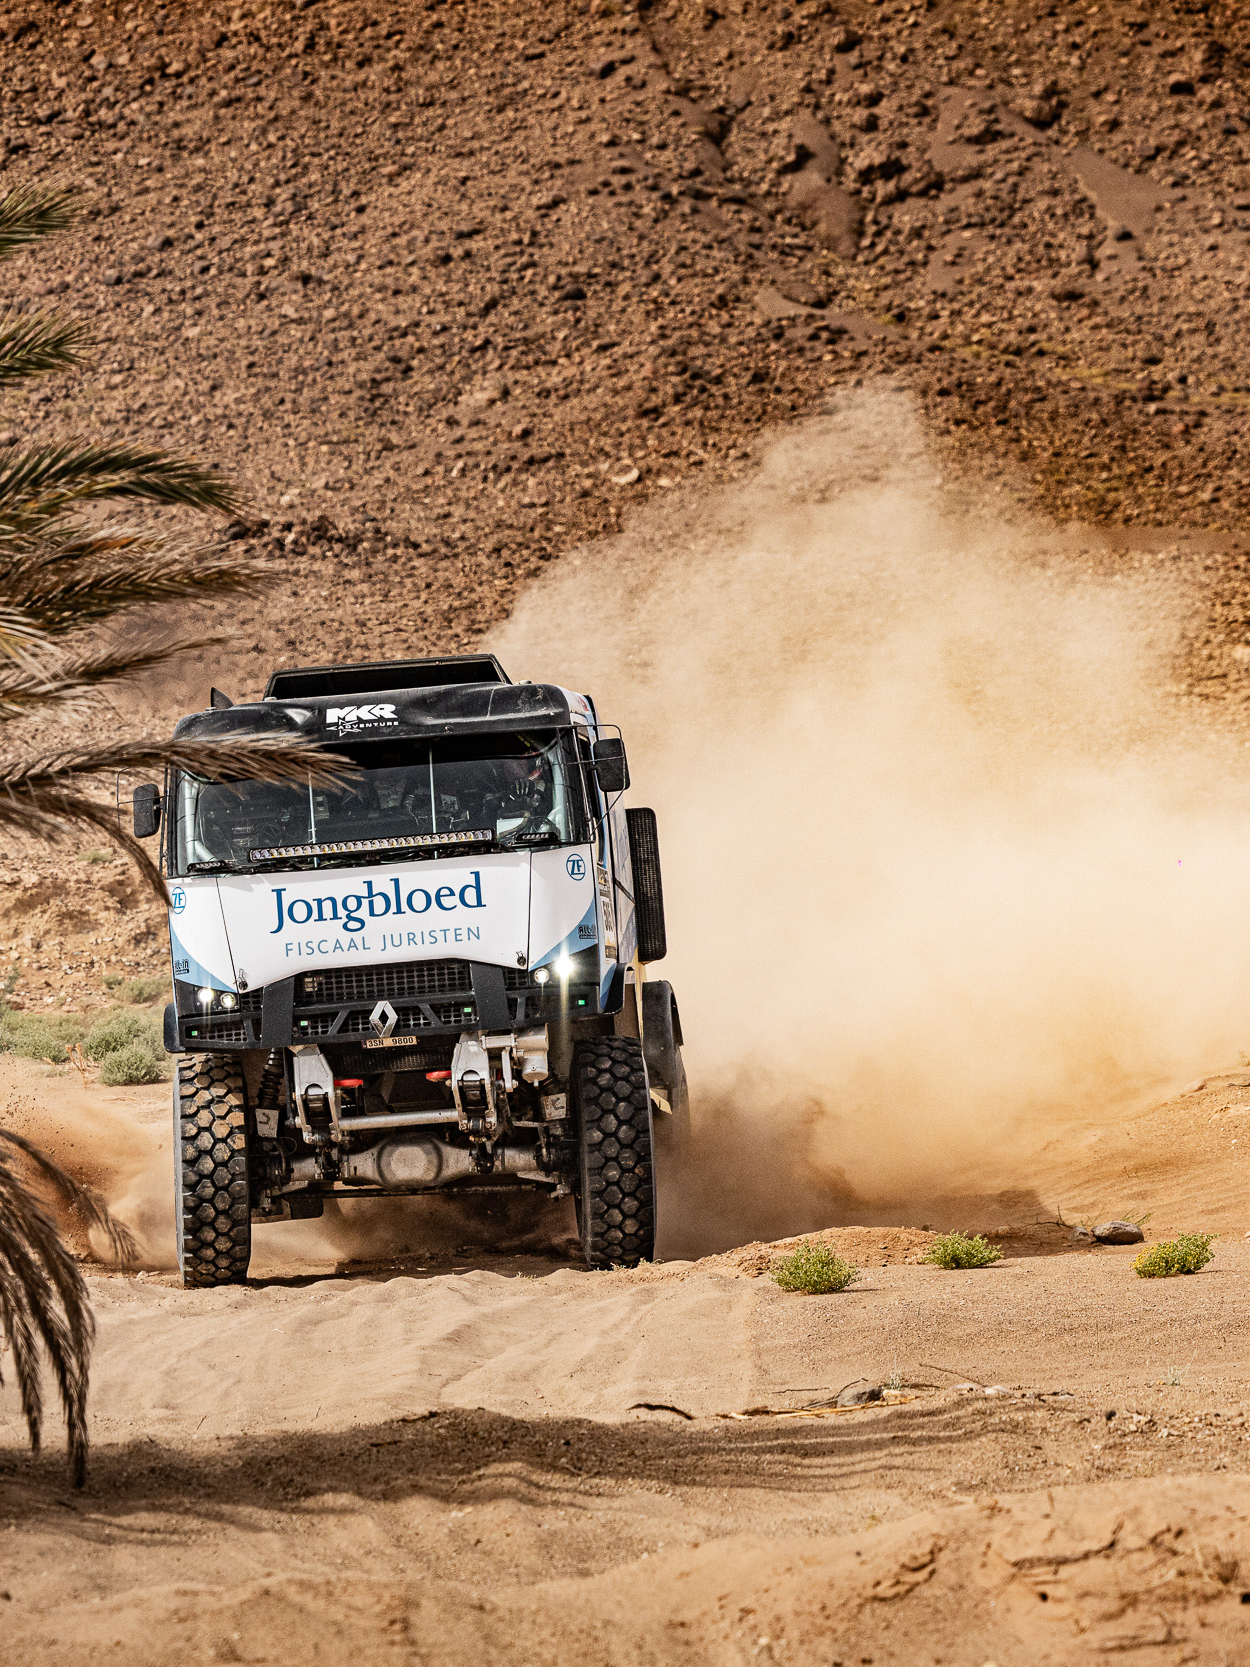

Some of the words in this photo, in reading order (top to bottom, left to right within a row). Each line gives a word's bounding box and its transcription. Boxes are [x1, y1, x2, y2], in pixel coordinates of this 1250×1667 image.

[326, 704, 398, 723] MKR
[338, 721, 399, 730] ADVENTURE
[567, 859, 585, 875] ZF
[270, 871, 487, 933] Jongbloed
[285, 936, 371, 957] FISCAAL
[381, 926, 481, 951] JURISTEN
[391, 1036, 414, 1046] 9800
